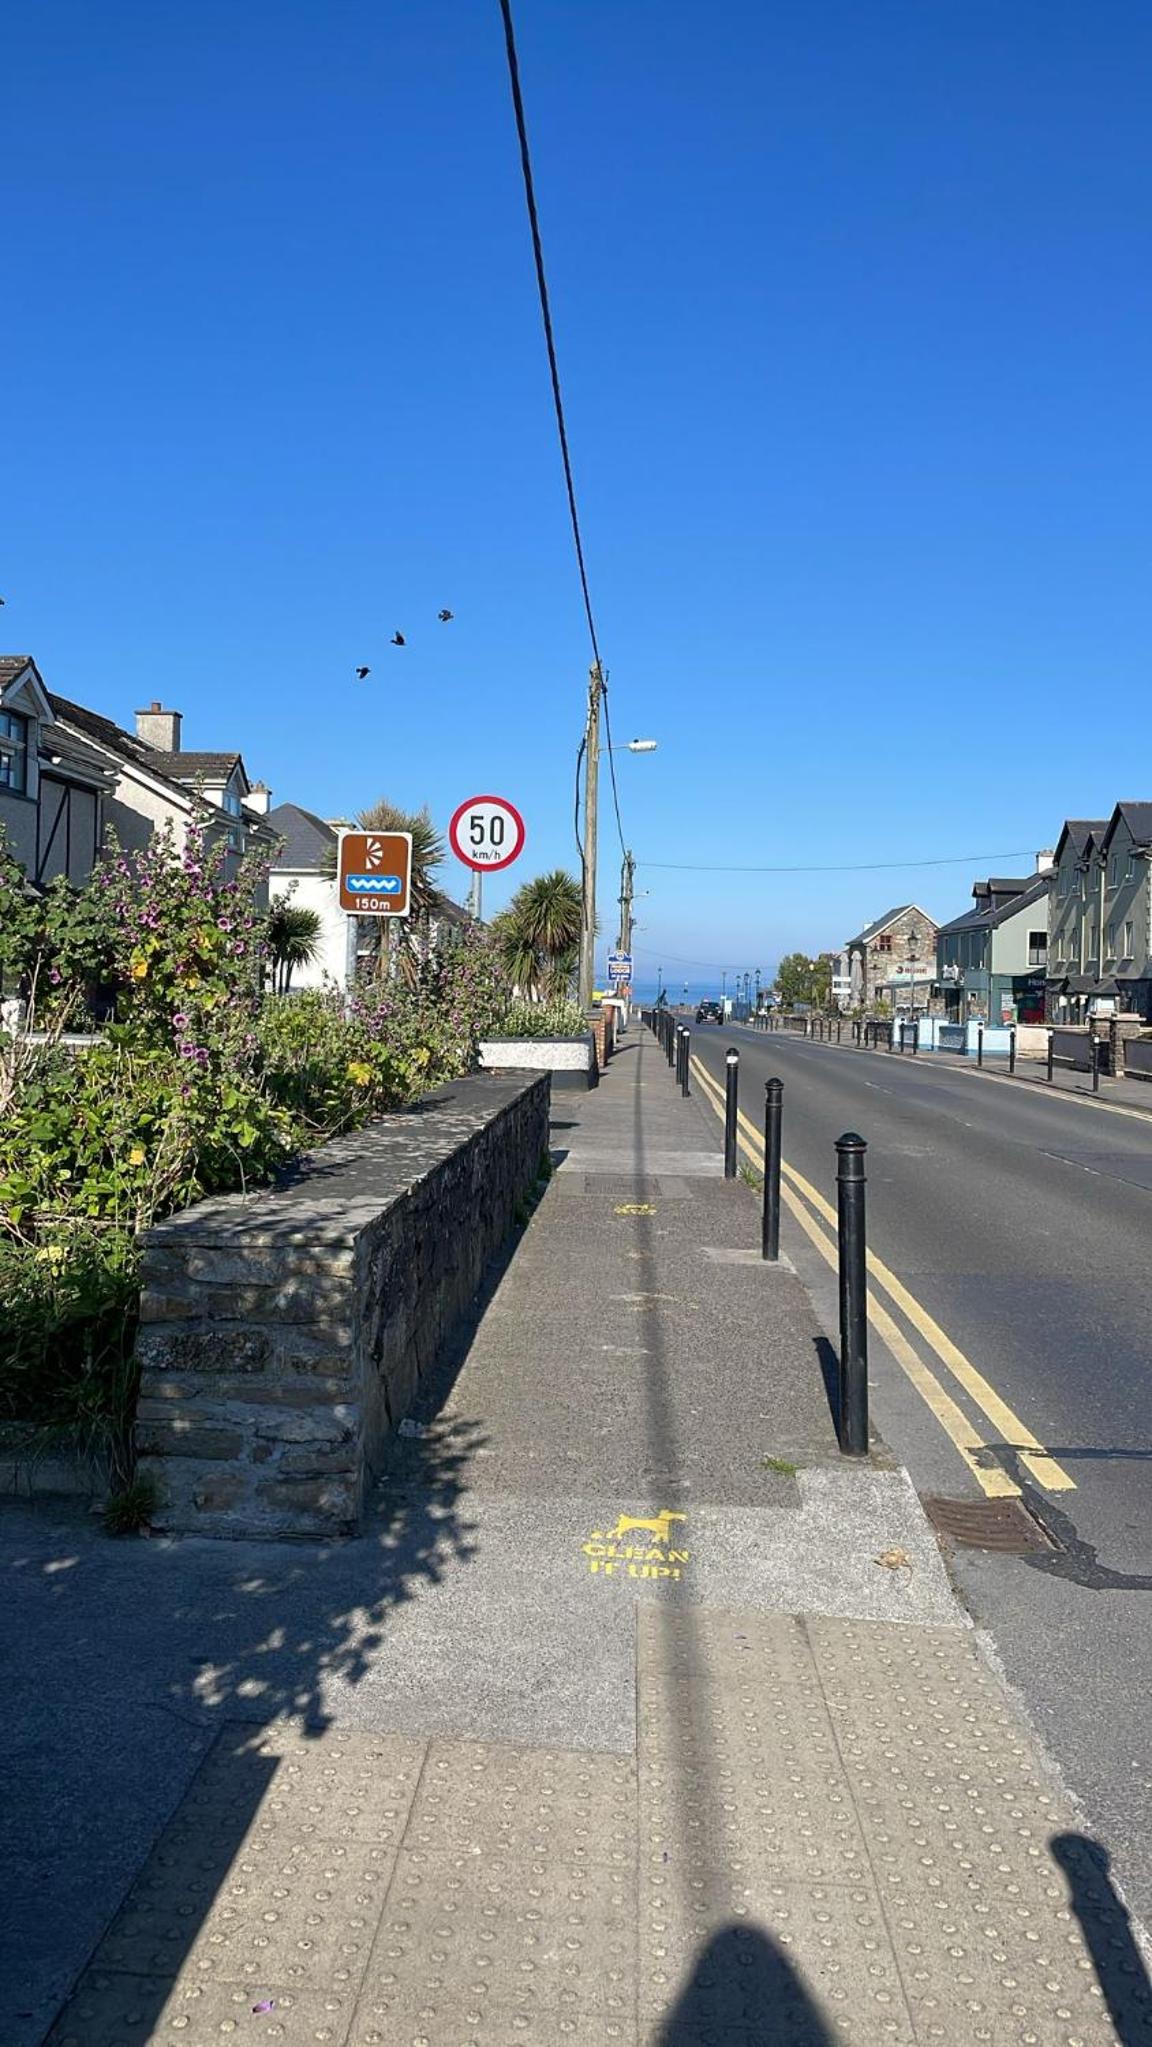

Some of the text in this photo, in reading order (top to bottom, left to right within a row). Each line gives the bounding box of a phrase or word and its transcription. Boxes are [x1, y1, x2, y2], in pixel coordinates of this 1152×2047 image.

[470, 816, 504, 846] 50
[473, 849, 501, 860] km/h
[355, 898, 390, 910] 150m
[582, 1545, 689, 1563] CLEAN
[590, 1561, 681, 1582] IT UP!
